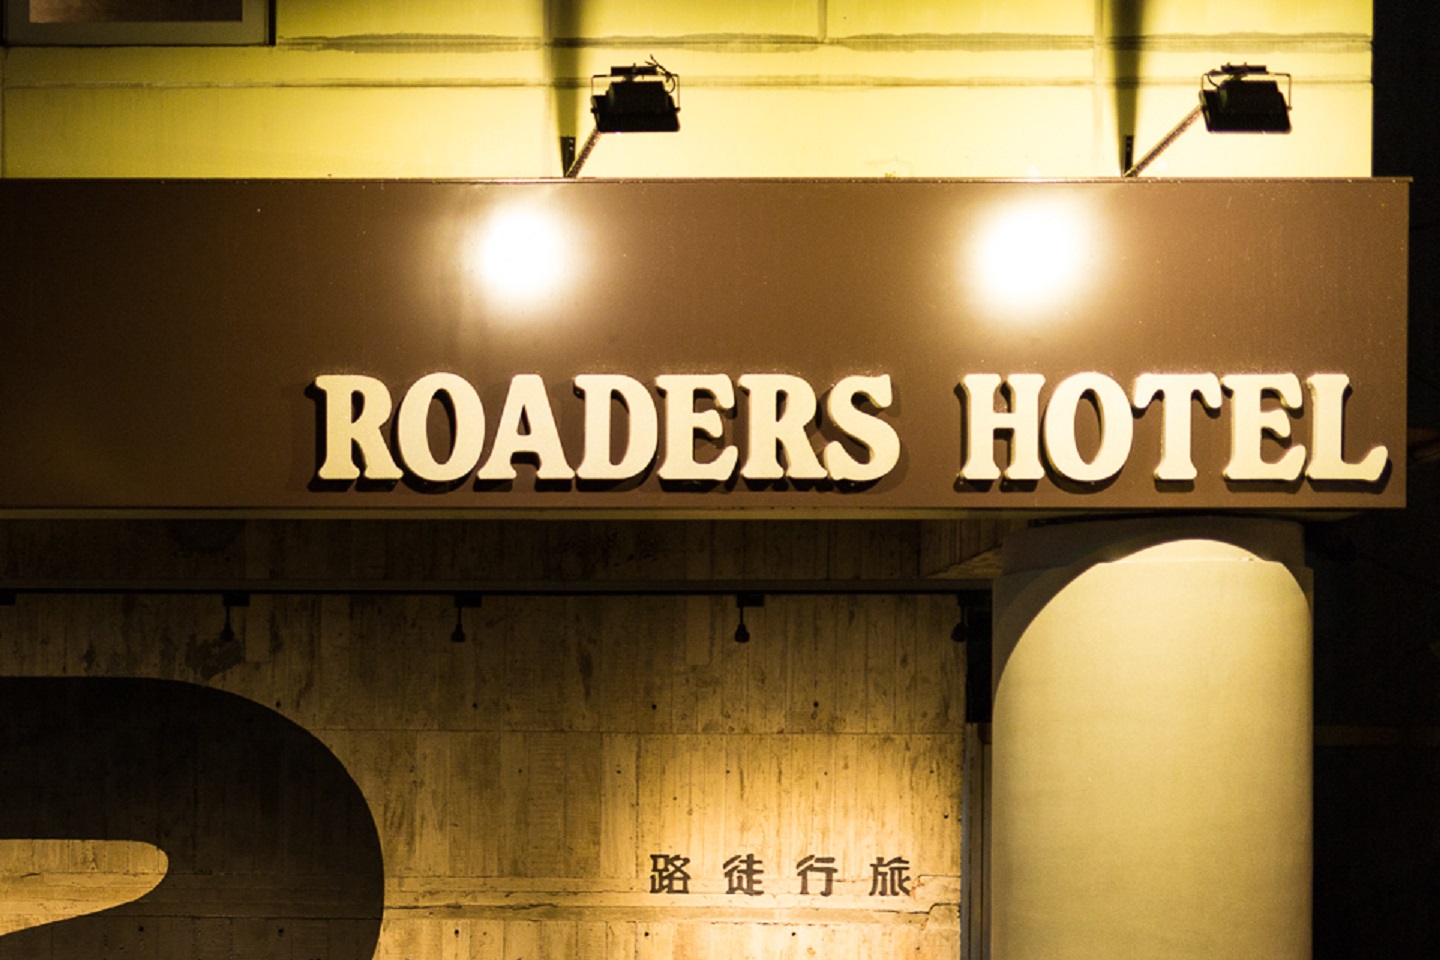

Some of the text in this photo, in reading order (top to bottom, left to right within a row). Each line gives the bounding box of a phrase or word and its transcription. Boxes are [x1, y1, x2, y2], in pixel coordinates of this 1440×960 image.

[313, 372, 1391, 484] ROADERS HOTEL
[649, 852, 913, 897] 路徒行旅
